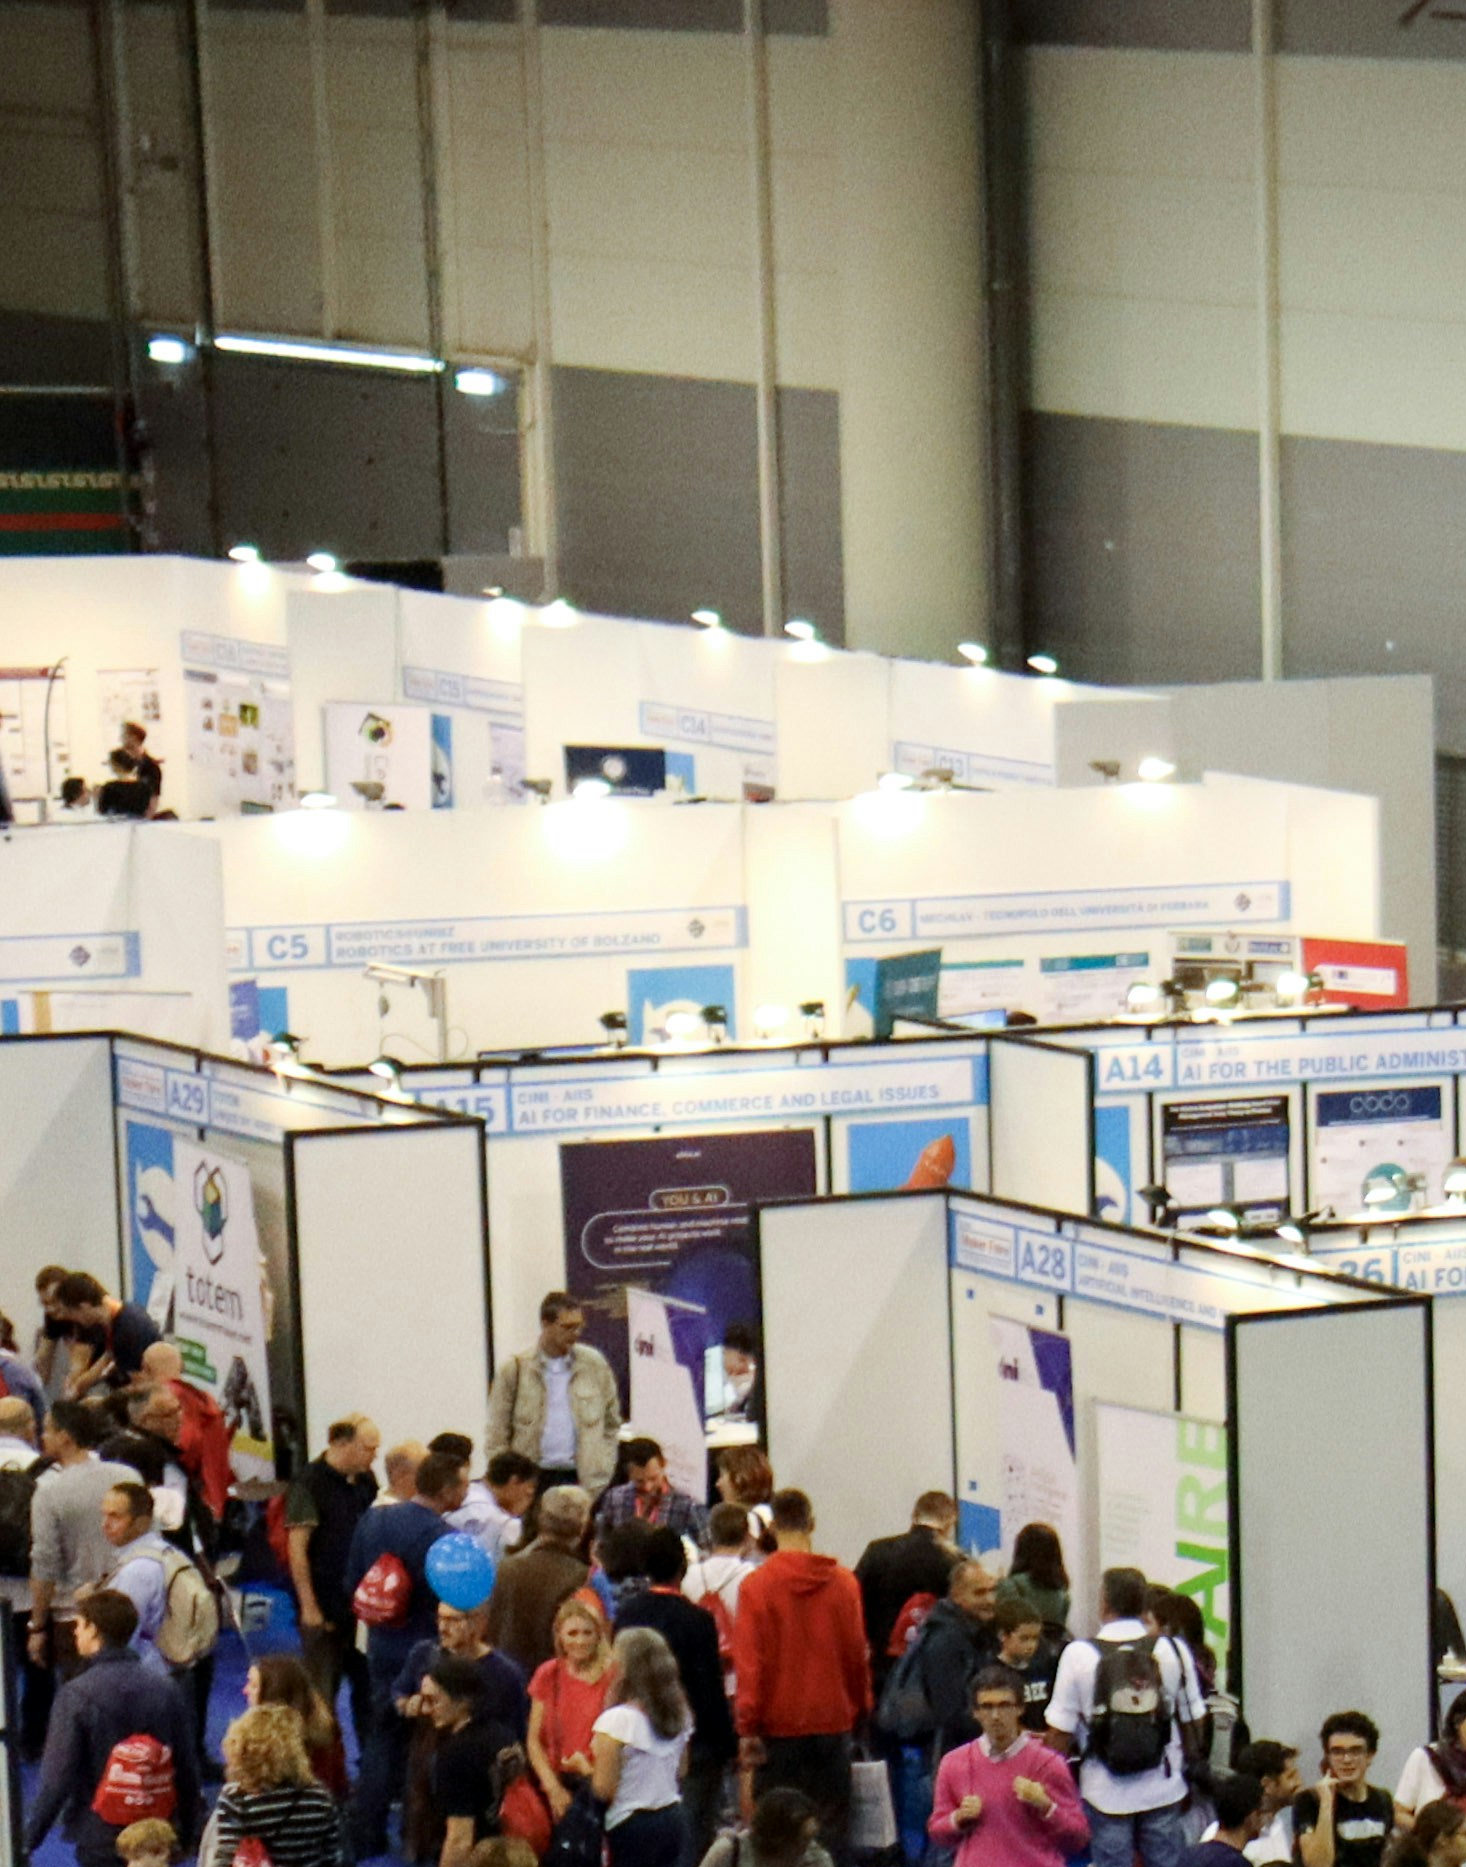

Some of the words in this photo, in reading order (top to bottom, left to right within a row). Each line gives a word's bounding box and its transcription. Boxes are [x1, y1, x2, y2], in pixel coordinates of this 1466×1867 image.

[858, 908, 897, 933] C6
[266, 934, 309, 961] C5
[336, 942, 413, 959] ROBOTICS
[418, 941, 435, 956] AT
[440, 940, 476, 955] FREE
[481, 936, 567, 953] UNIVERSITY
[571, 935, 589, 949] OF
[593, 931, 661, 948] BOLZANO
[1106, 1055, 1163, 1082] A14
[1182, 1064, 1201, 1081] AI
[1209, 1061, 1246, 1080] FOR
[1254, 1058, 1292, 1077] THE
[1299, 1054, 1369, 1075] PUBLIC
[170, 1074, 205, 1114] A29
[519, 1107, 538, 1125] AI
[542, 1105, 579, 1123] FOR
[583, 1101, 665, 1122] FINANCE,
[673, 1095, 774, 1116] COMMERCE
[779, 1091, 816, 1109] AND
[821, 1088, 874, 1107] LEGAL
[878, 1083, 940, 1103] ISSUES
[1021, 1241, 1066, 1281] A28
[186, 1266, 243, 1320] totem
[1405, 1269, 1428, 1291] AI
